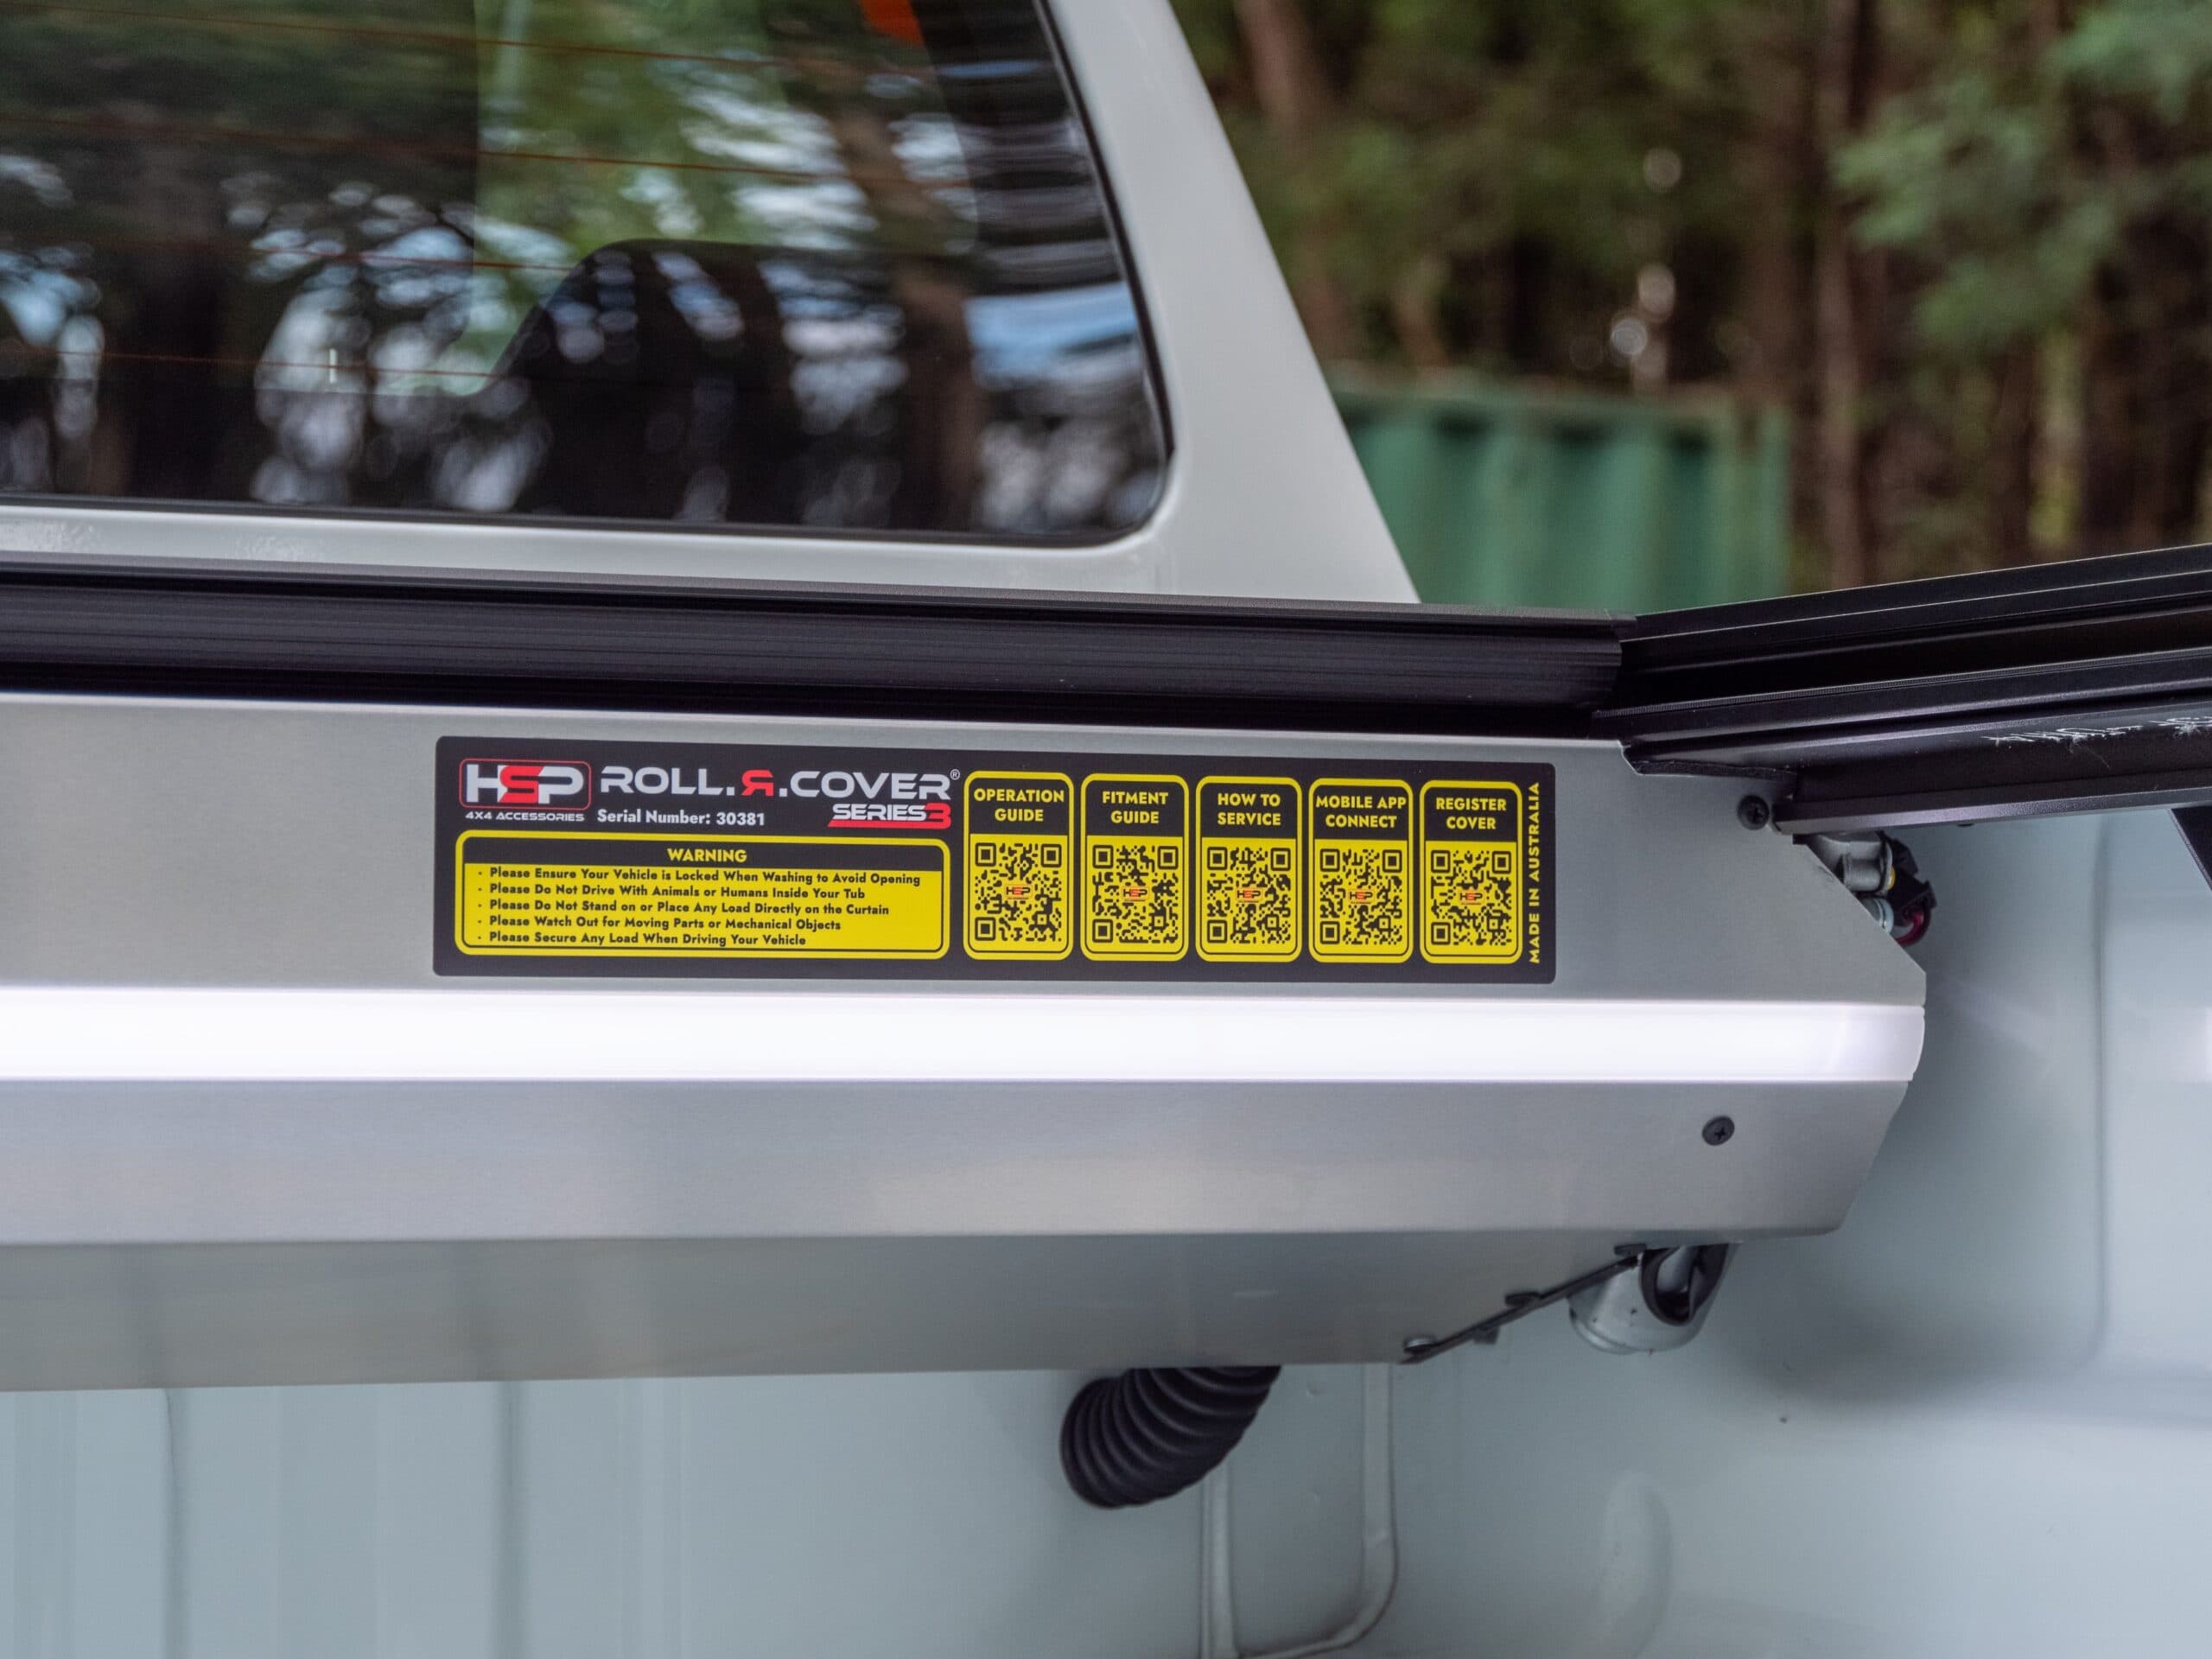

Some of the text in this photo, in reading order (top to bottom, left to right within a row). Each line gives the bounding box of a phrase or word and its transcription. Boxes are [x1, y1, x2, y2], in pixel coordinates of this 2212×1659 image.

[467, 764, 584, 804] HSP
[974, 788, 1065, 803] OPERATION
[1102, 791, 1168, 805] FITMENT
[1217, 793, 1281, 807] HOW TO
[1316, 796, 1406, 809] MOBILE APP
[1436, 798, 1507, 810] REGISTER
[496, 812, 584, 822] ACCESSORIES
[597, 809, 765, 825] Serial Number: 30381
[995, 809, 1044, 822] GUIDE
[1110, 810, 1159, 823] GUIDE
[1217, 812, 1281, 825] SERVICE
[1325, 815, 1397, 828] CONNECT
[1446, 817, 1497, 830] COVER
[667, 849, 747, 863] WARNING
[490, 868, 920, 887] Please Ensure Your Vehicle is Locked When Washing to Avoid Opening
[1529, 783, 1540, 963] MADE IN AUSTRALIA
[490, 883, 530, 894] Please
[535, 884, 551, 894] Do
[556, 885, 578, 894] Not
[582, 885, 614, 895] Drive
[619, 885, 647, 896] With
[652, 886, 699, 897] Animals
[721, 887, 768, 898] Humans
[772, 888, 809, 898] Inside
[813, 889, 841, 899] Your
[843, 889, 865, 899] Tub
[490, 899, 530, 910] Please
[535, 900, 550, 910] Do
[556, 900, 578, 911] Not
[582, 900, 617, 912] Stand
[658, 901, 690, 912] Place
[694, 902, 717, 916] Any
[721, 903, 750, 913] Load
[755, 903, 801, 916] Directly
[823, 904, 842, 914] the
[846, 905, 889, 915] Curtain
[490, 915, 530, 926] Please
[534, 916, 572, 927] Watch
[576, 916, 599, 927] Out
[602, 916, 620, 927] for
[625, 918, 669, 930] Moving
[674, 918, 704, 929] Parts
[725, 918, 791, 929] Mechanical
[796, 919, 841, 931] Objects
[490, 931, 806, 947] Please Secure Any Load When Driving Your Vehicle
